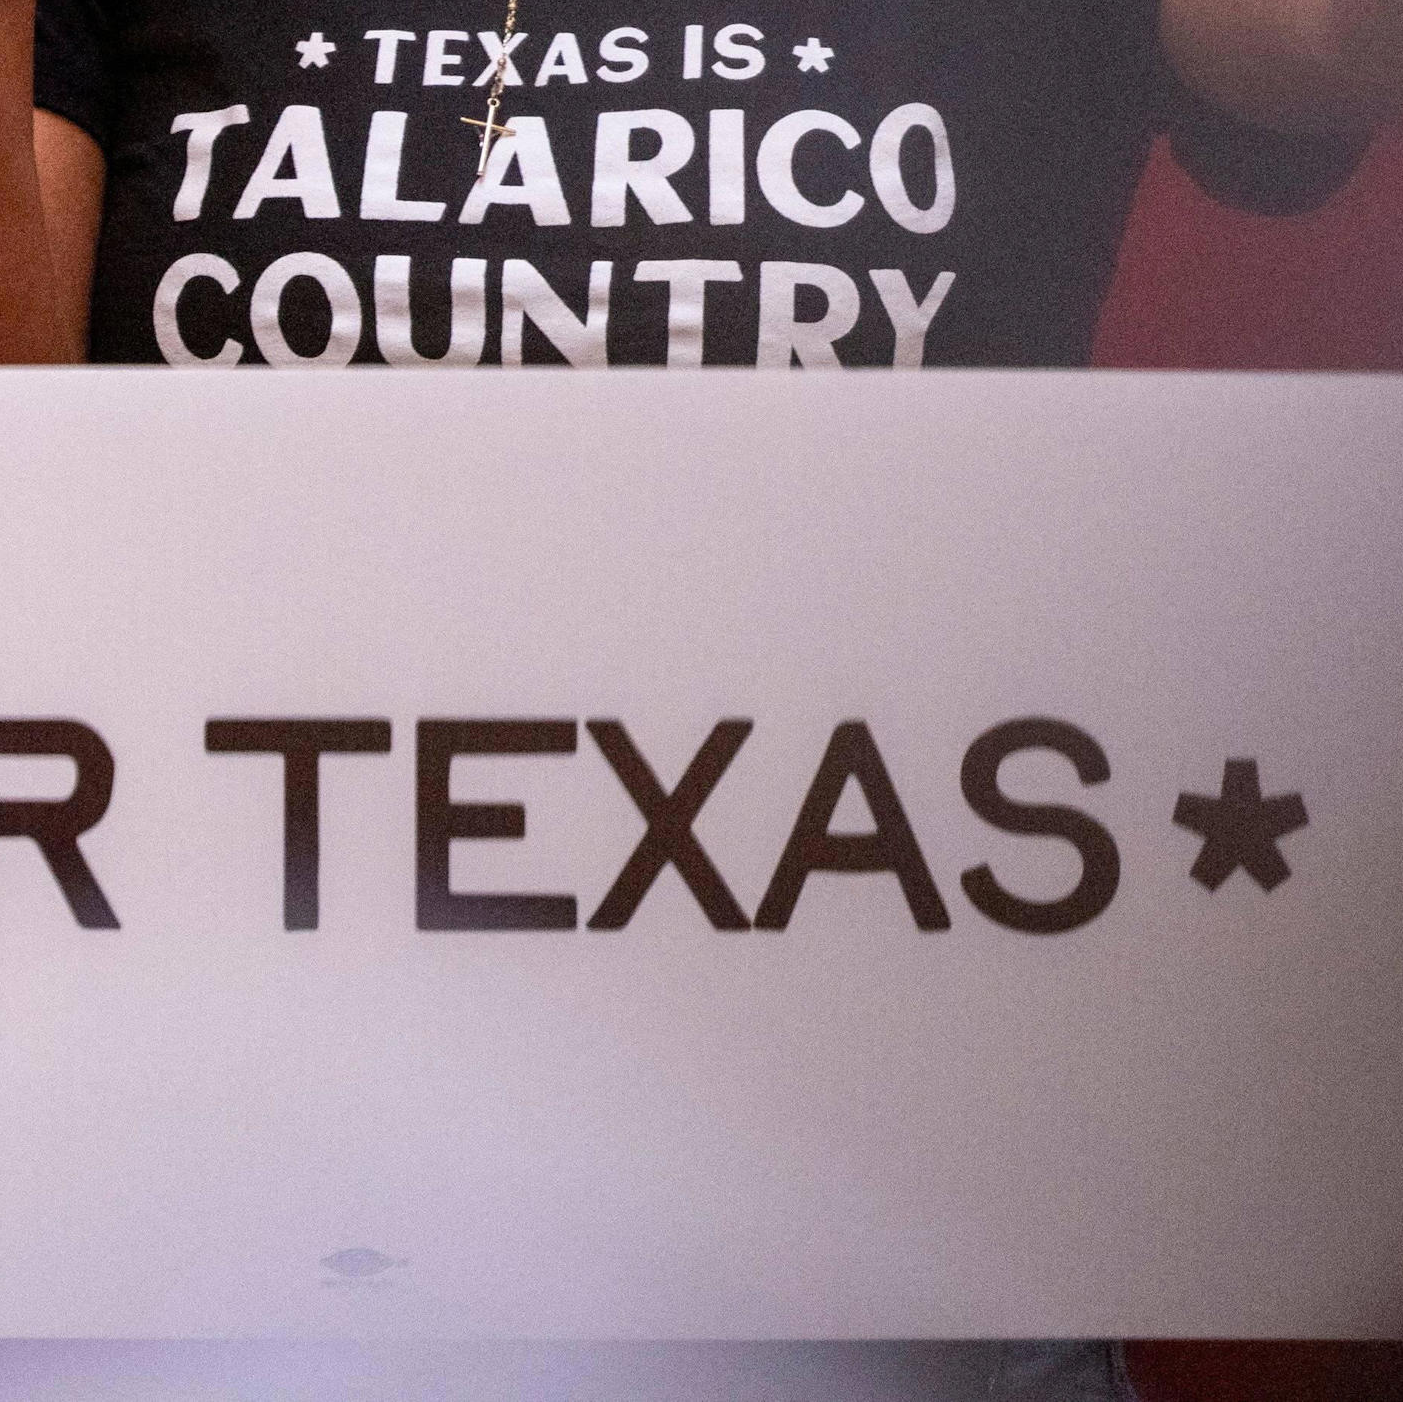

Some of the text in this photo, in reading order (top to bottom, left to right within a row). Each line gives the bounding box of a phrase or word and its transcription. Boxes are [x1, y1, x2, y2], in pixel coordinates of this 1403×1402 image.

[363, 22, 767, 88] TEXAS IS
[169, 101, 957, 235] TALARICO
[152, 250, 957, 369] COUNTRY
[204, 715, 1122, 938] TEXAS
